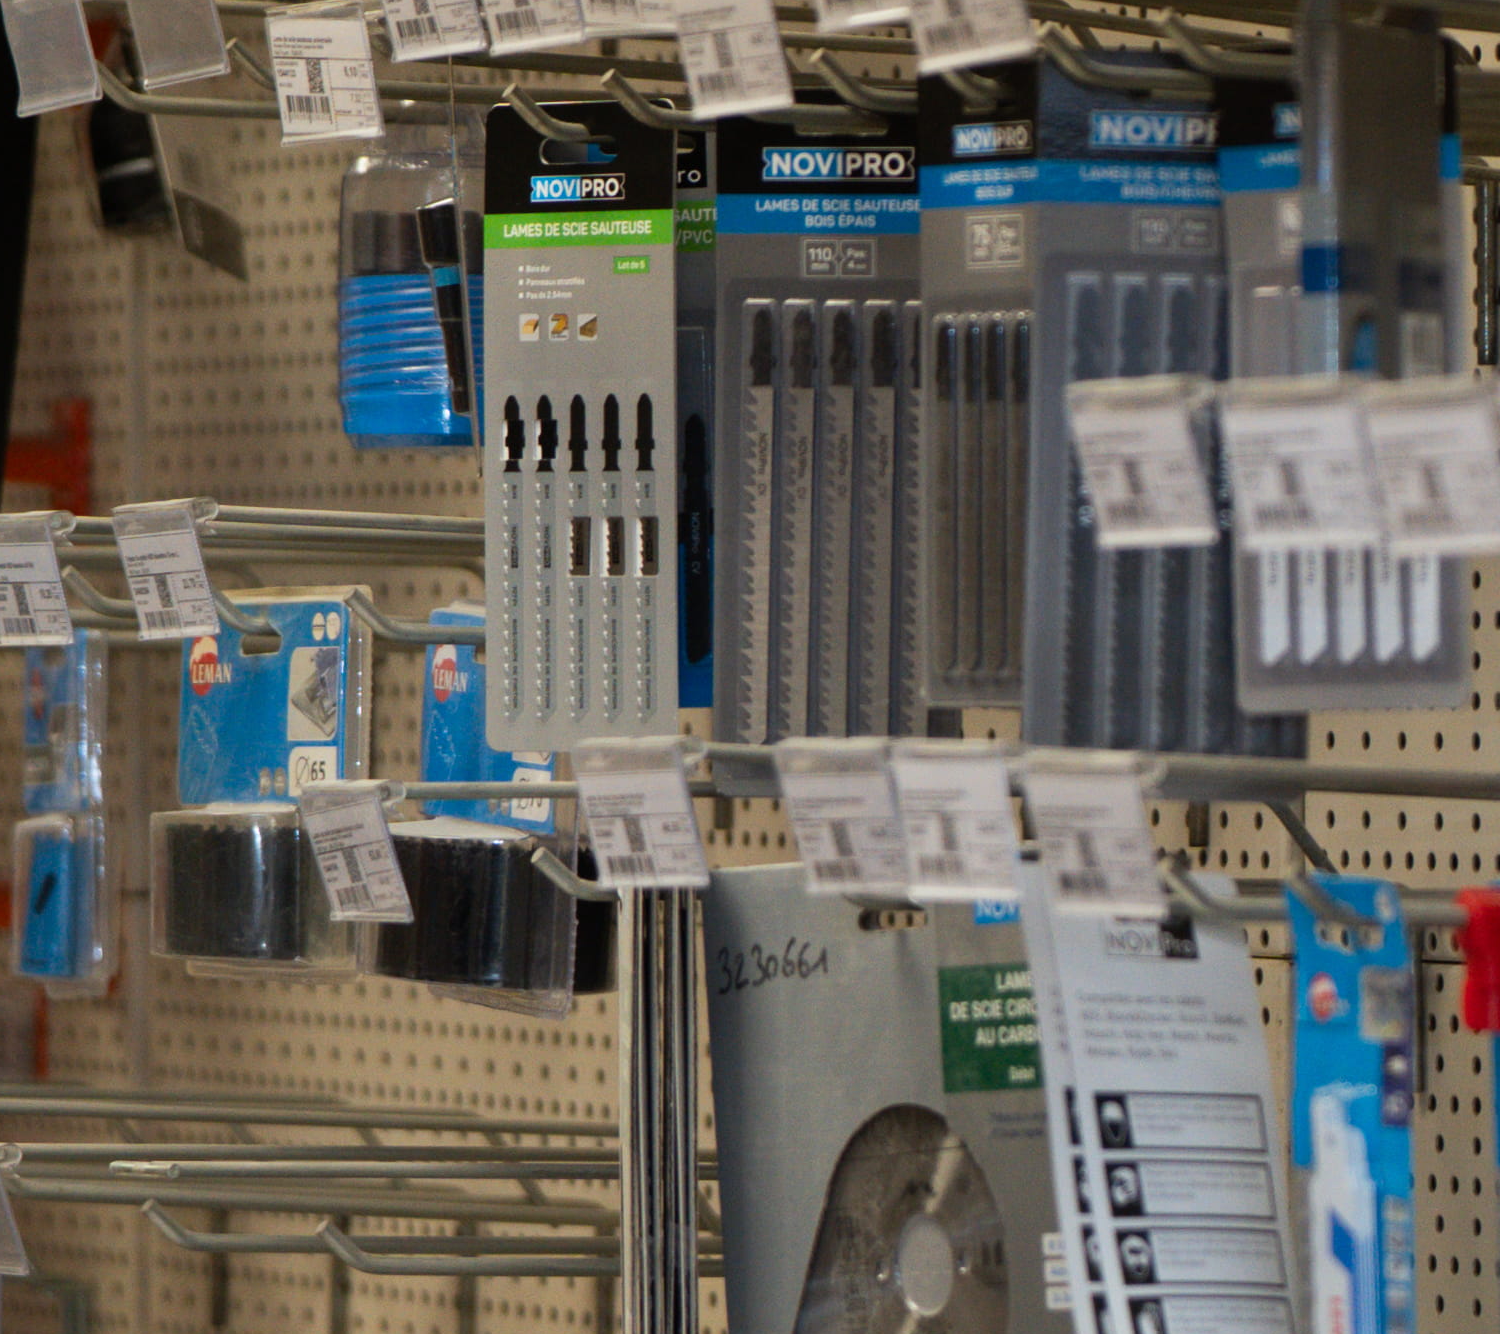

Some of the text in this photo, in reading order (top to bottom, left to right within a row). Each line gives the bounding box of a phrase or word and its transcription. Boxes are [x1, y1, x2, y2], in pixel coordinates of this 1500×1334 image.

[955, 125, 1028, 155] NOVIPRO
[770, 151, 906, 176] NOVIPRO
[535, 177, 620, 199] NOVIPRO
[755, 199, 800, 212] LAMES
[802, 199, 819, 211] DE
[822, 199, 850, 211] SCIE
[503, 219, 653, 238] LAMES DE SCIE SAUTEUSE
[804, 212, 876, 228] BOIS ÉPAIS
[808, 247, 832, 261] 110
[191, 661, 232, 685] LEMAN
[432, 667, 467, 692] LEMAN
[717, 936, 829, 995] 3230661
[950, 1001, 969, 1021] DE
[973, 999, 1003, 1020] SCIE
[975, 1024, 1041, 1047] AU CARB
